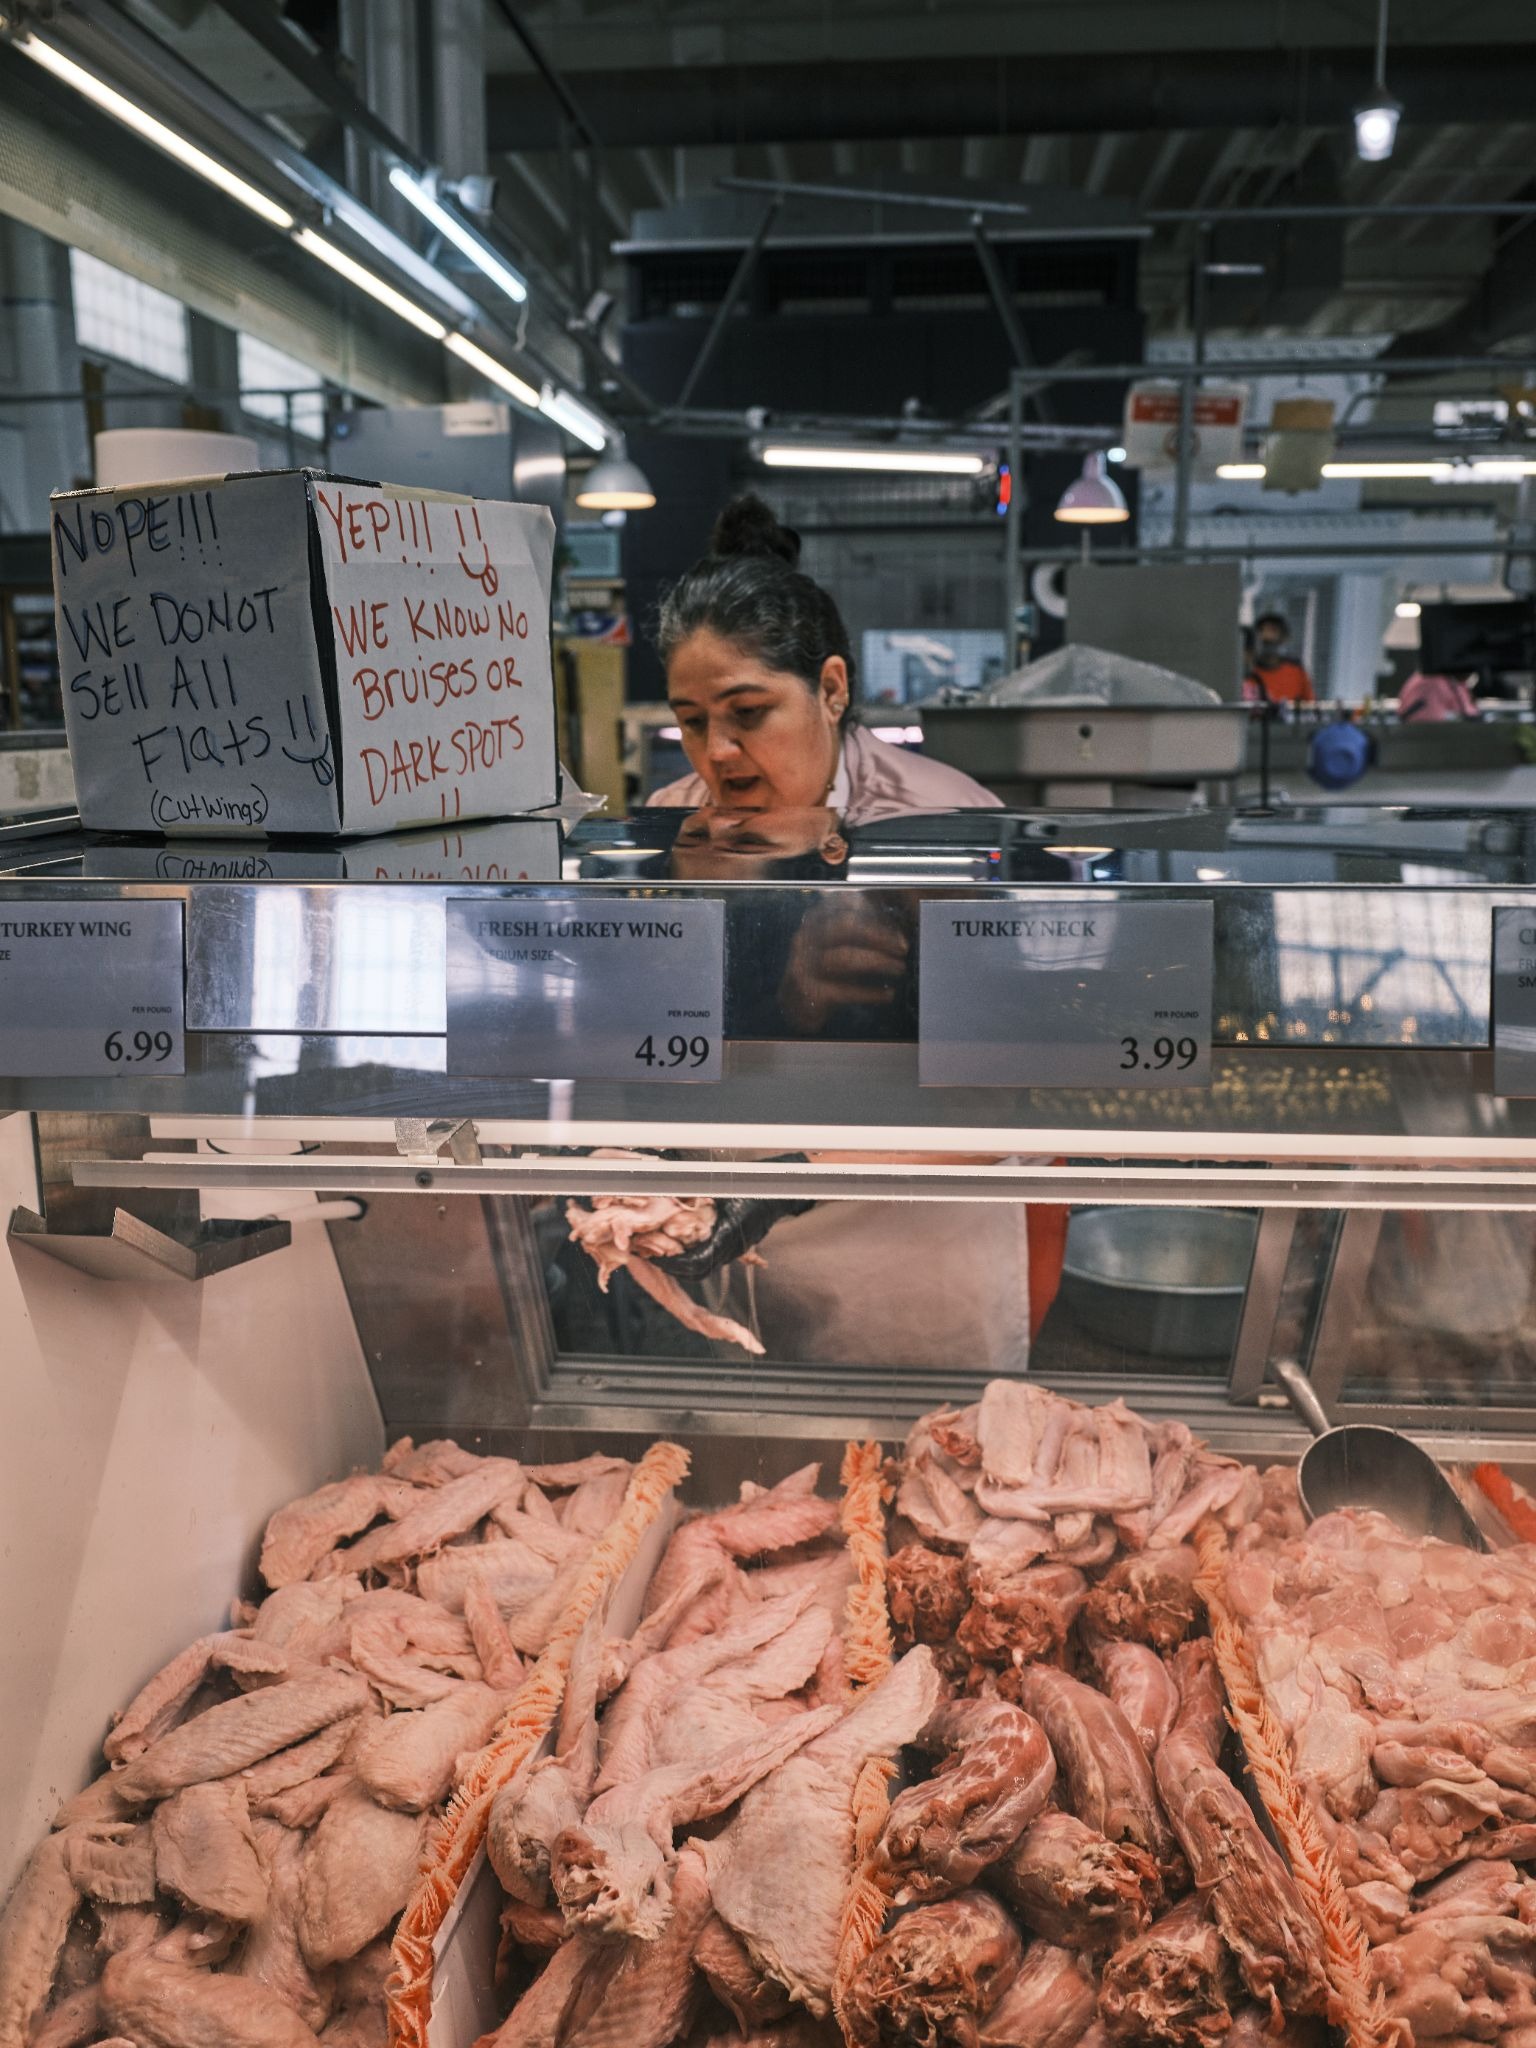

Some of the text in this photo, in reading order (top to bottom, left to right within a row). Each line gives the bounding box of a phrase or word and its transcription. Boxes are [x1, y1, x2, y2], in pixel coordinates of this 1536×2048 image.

[62, 597, 135, 662] WE
[334, 599, 389, 657] WE
[404, 597, 489, 643] KNOW
[486, 656, 522, 692] OR
[360, 715, 524, 806] DARK SPOTS
[0, 921, 132, 938] TURKEY WING
[478, 920, 683, 938] FRESH TURKEY WING
[952, 920, 1096, 937] TURKEY NECK
[530, 949, 554, 960] SIZE
[132, 1006, 172, 1014] PER POUND
[668, 1010, 710, 1018] PER POUND
[1154, 1011, 1199, 1019] PER POUND
[104, 1030, 173, 1062] 6.99
[635, 1035, 709, 1068] 4.99
[1120, 1036, 1198, 1070] 3.99
